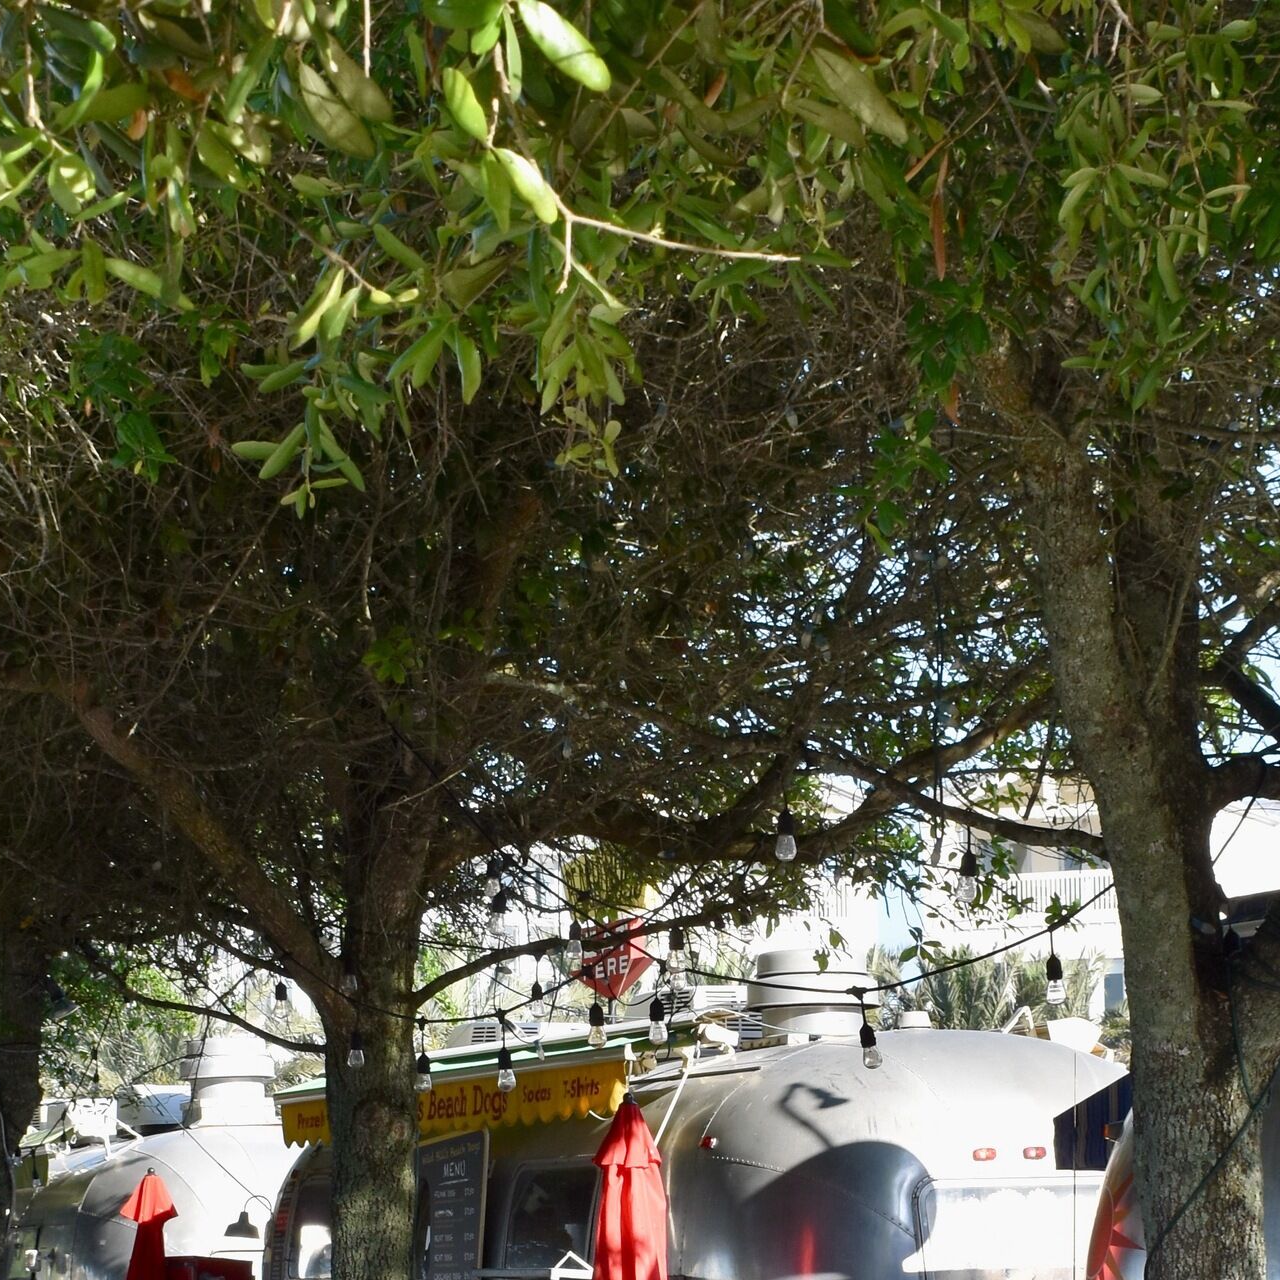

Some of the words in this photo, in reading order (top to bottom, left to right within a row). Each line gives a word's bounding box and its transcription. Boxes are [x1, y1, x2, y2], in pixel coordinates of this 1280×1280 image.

[427, 1090, 468, 1121] Beach
[472, 1086, 509, 1123] Dogs
[522, 1083, 552, 1103] Sodas
[562, 1076, 601, 1100] T-Shirts
[443, 1160, 467, 1178] MENU
